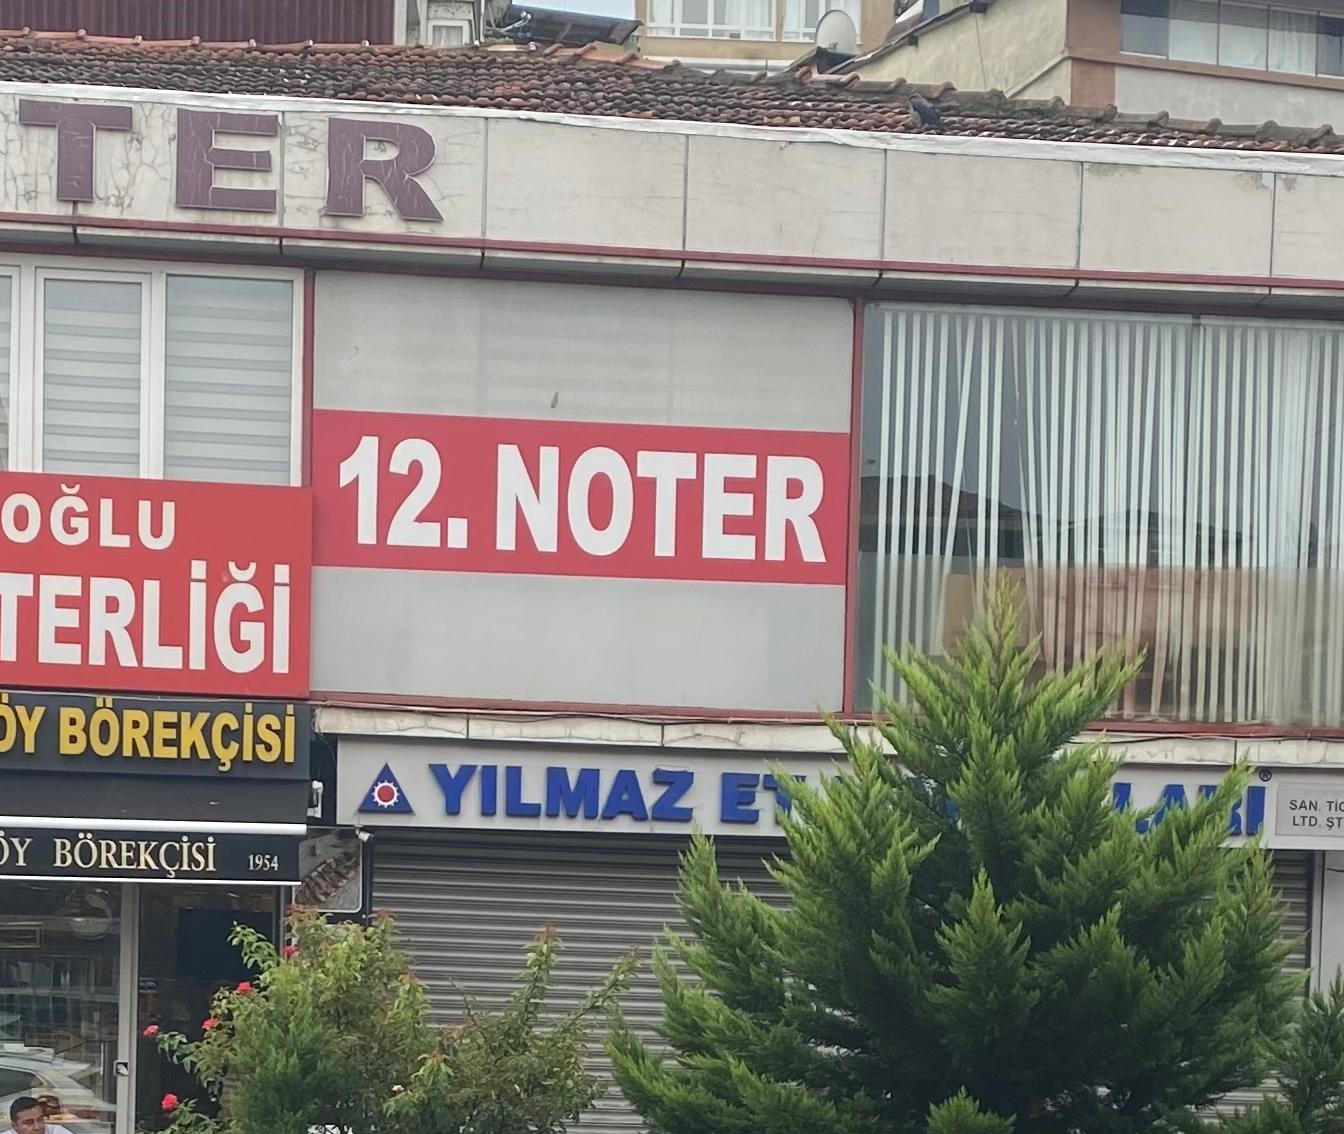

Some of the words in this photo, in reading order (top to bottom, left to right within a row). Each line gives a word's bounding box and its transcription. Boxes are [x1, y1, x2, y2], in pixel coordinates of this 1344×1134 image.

[339, 434, 469, 549] 12.
[495, 443, 828, 563] NOTER
[59, 695, 296, 772] BÖREKÇİSİ
[428, 763, 695, 822] YILMAZ
[1288, 799, 1321, 812] SAN.
[1292, 815, 1321, 828] LTD.
[53, 832, 218, 879] BÖREKÇİSİ
[247, 853, 280, 873] 1954
